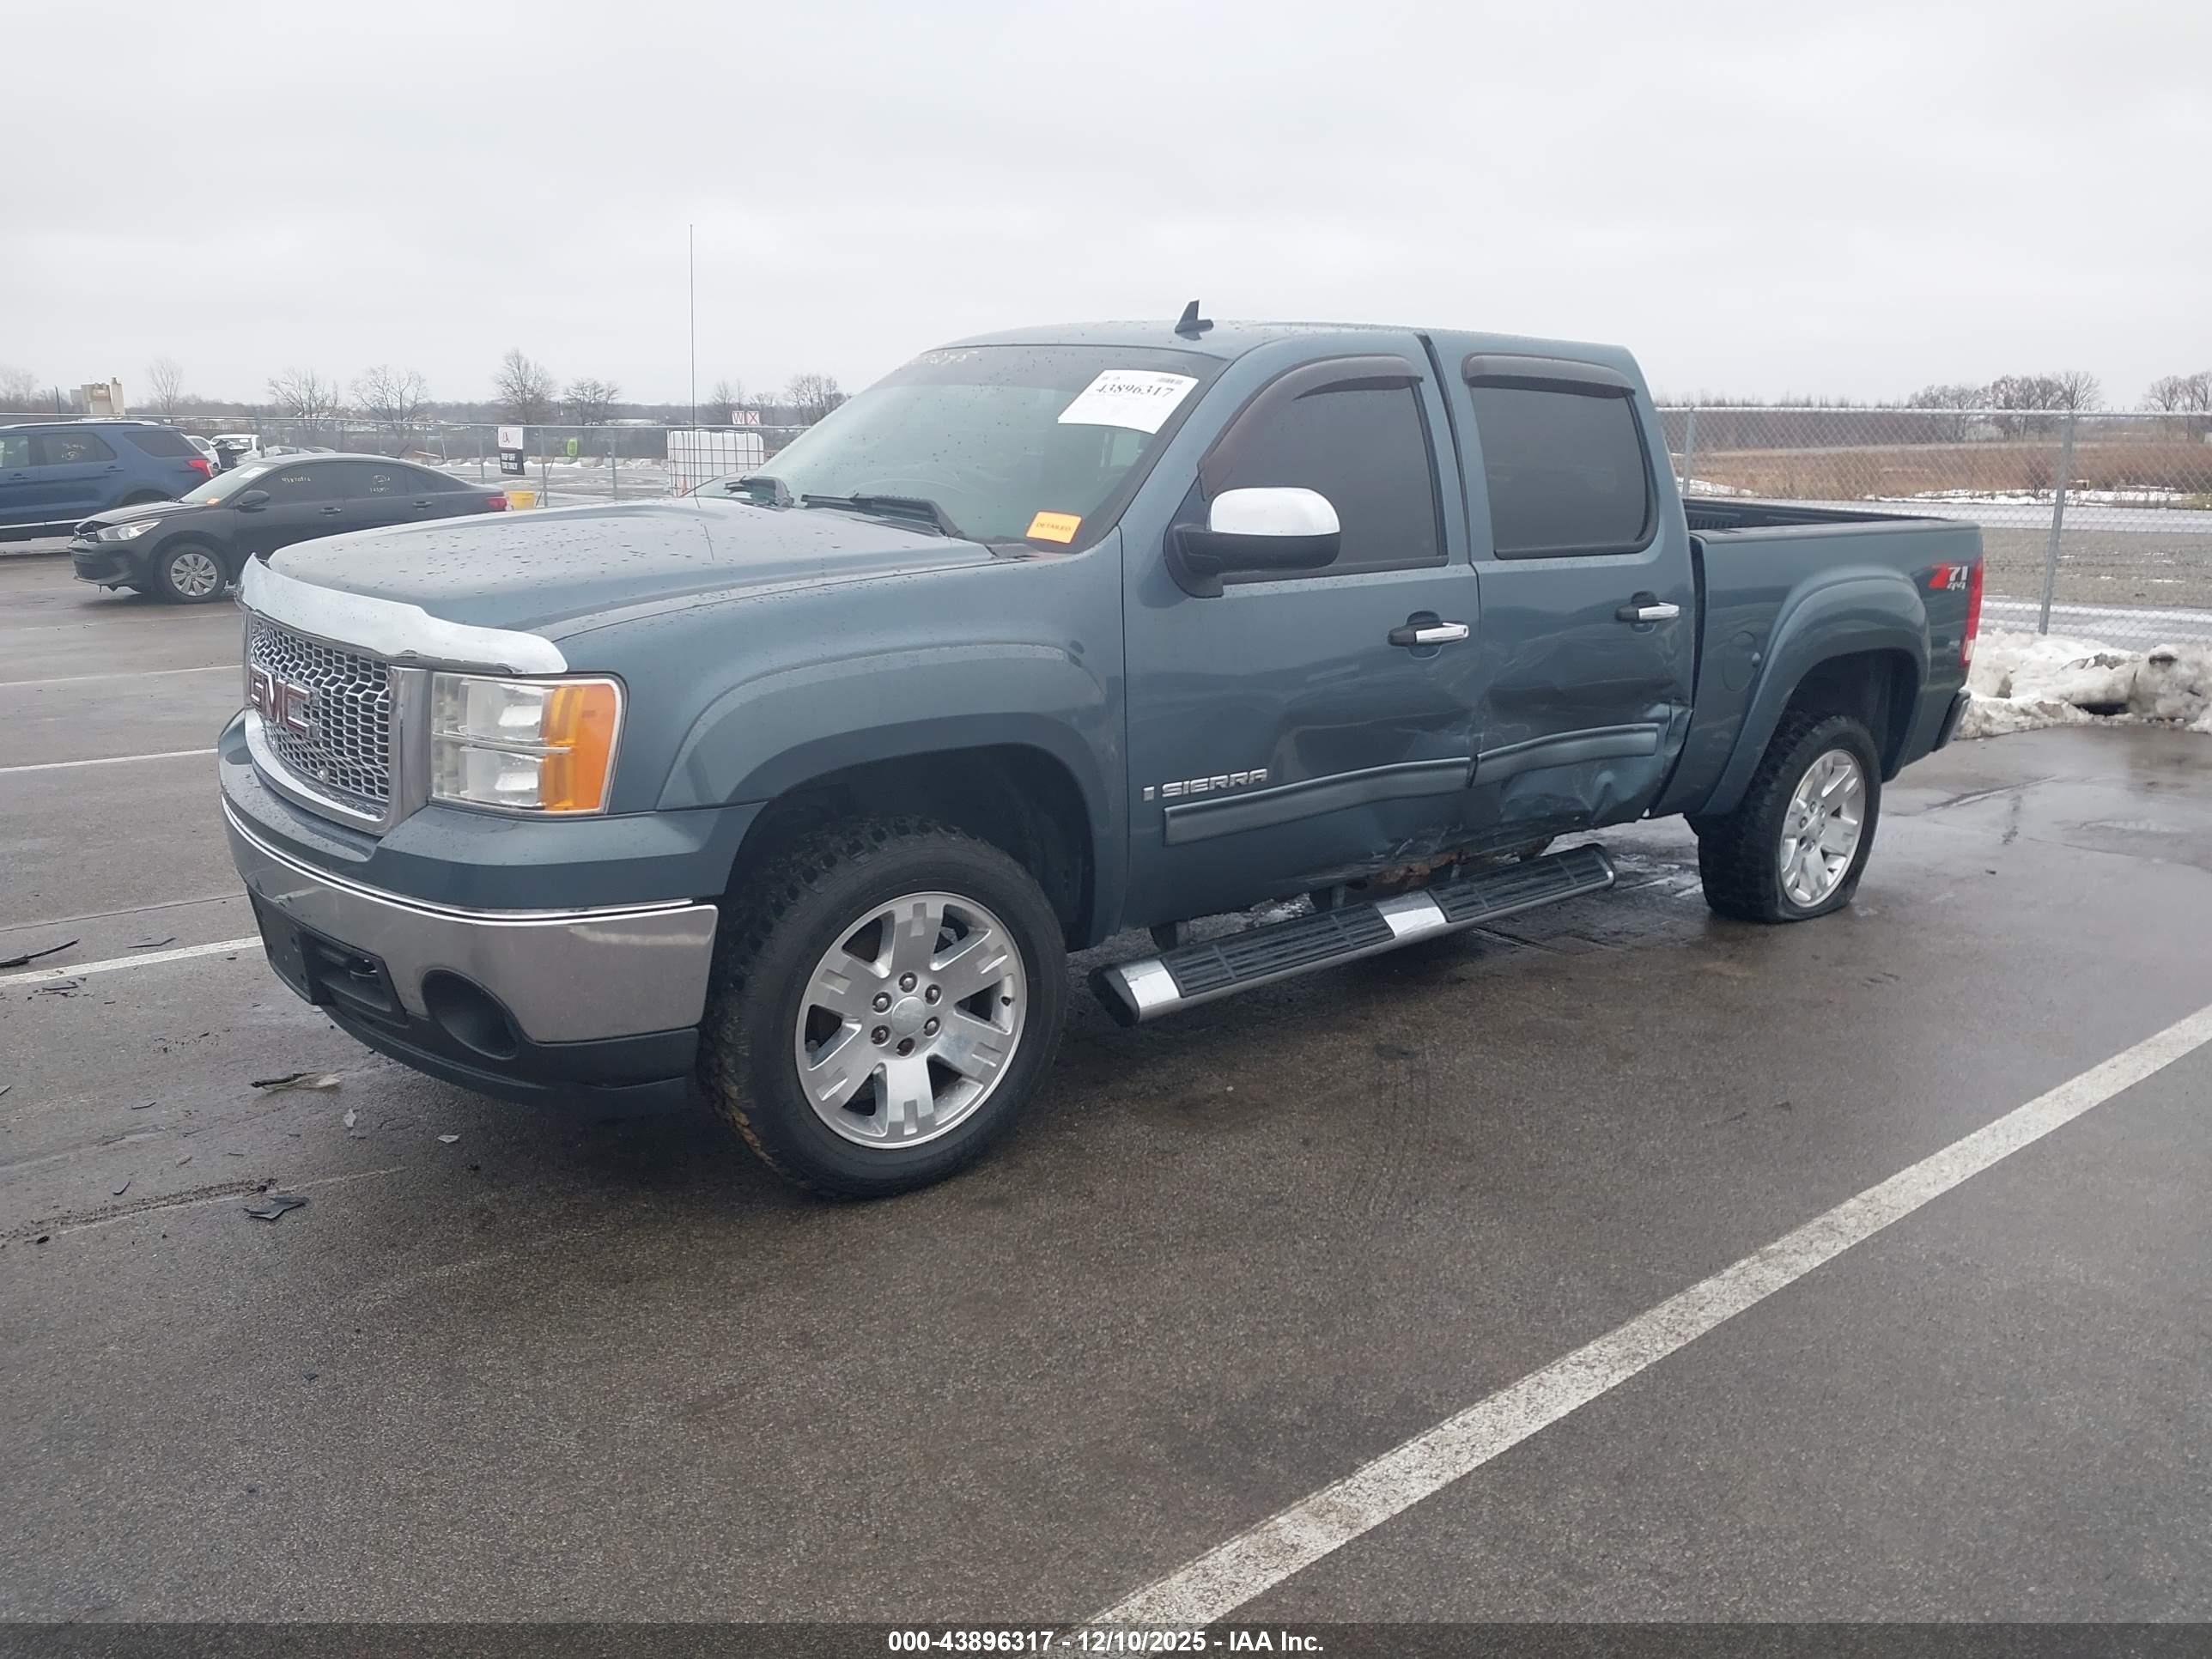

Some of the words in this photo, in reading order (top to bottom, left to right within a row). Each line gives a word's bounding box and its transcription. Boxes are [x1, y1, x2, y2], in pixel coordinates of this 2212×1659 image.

[1097, 384, 1175, 398] 43896317
[732, 411, 744, 423] W
[748, 411, 758, 424] X
[1929, 562, 1969, 589] Z71
[250, 664, 319, 739] GMC
[1162, 768, 1268, 798] SIERRA
